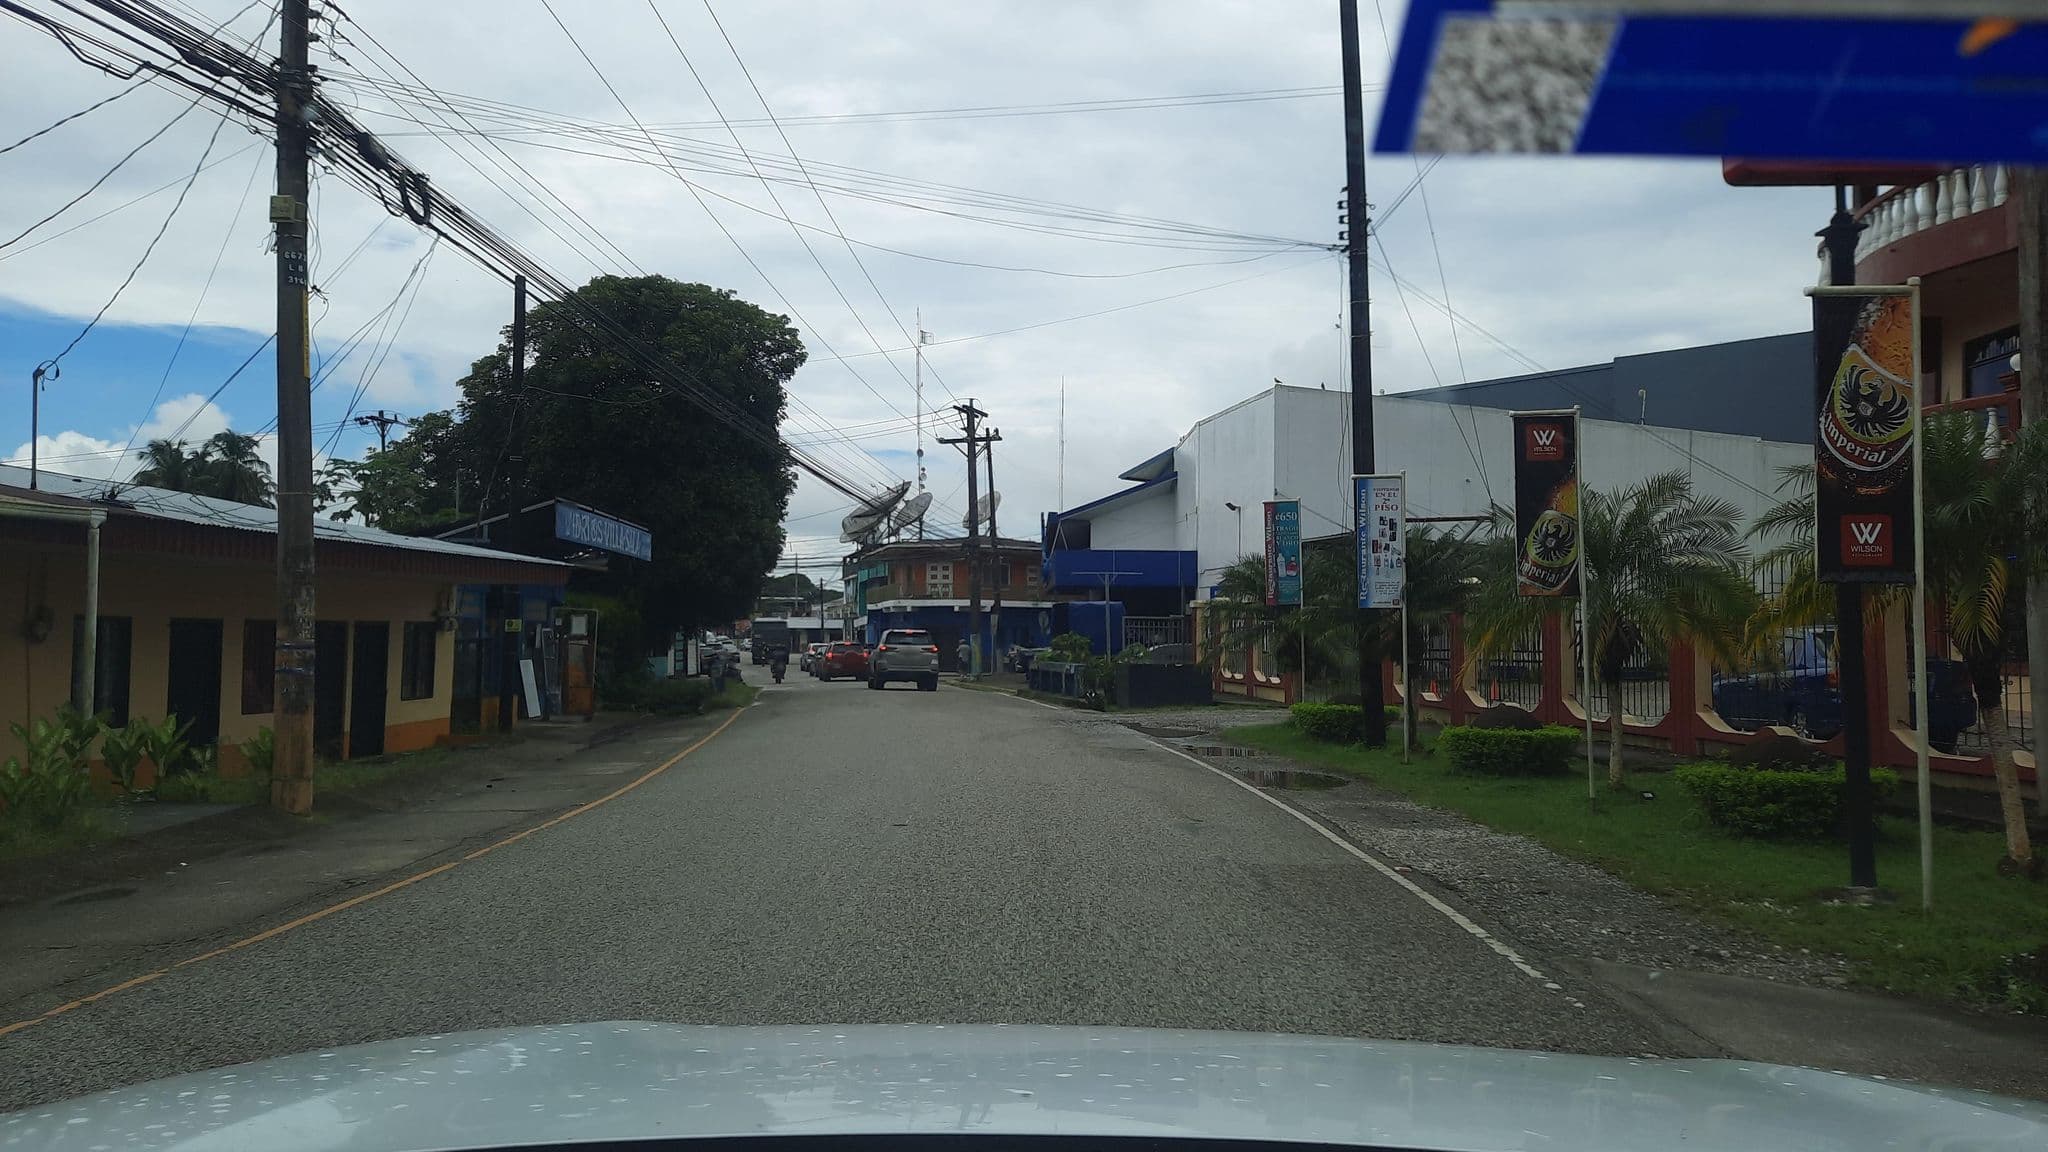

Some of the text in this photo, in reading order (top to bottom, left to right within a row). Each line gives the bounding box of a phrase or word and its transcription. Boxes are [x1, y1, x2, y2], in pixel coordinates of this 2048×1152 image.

[1825, 411, 1887, 463] Imperial
[1359, 489, 1367, 528] Wilson
[1359, 530, 1368, 600] Restaurante
[1850, 545, 1883, 553] WILSON
[1519, 559, 1560, 584] Imperial
